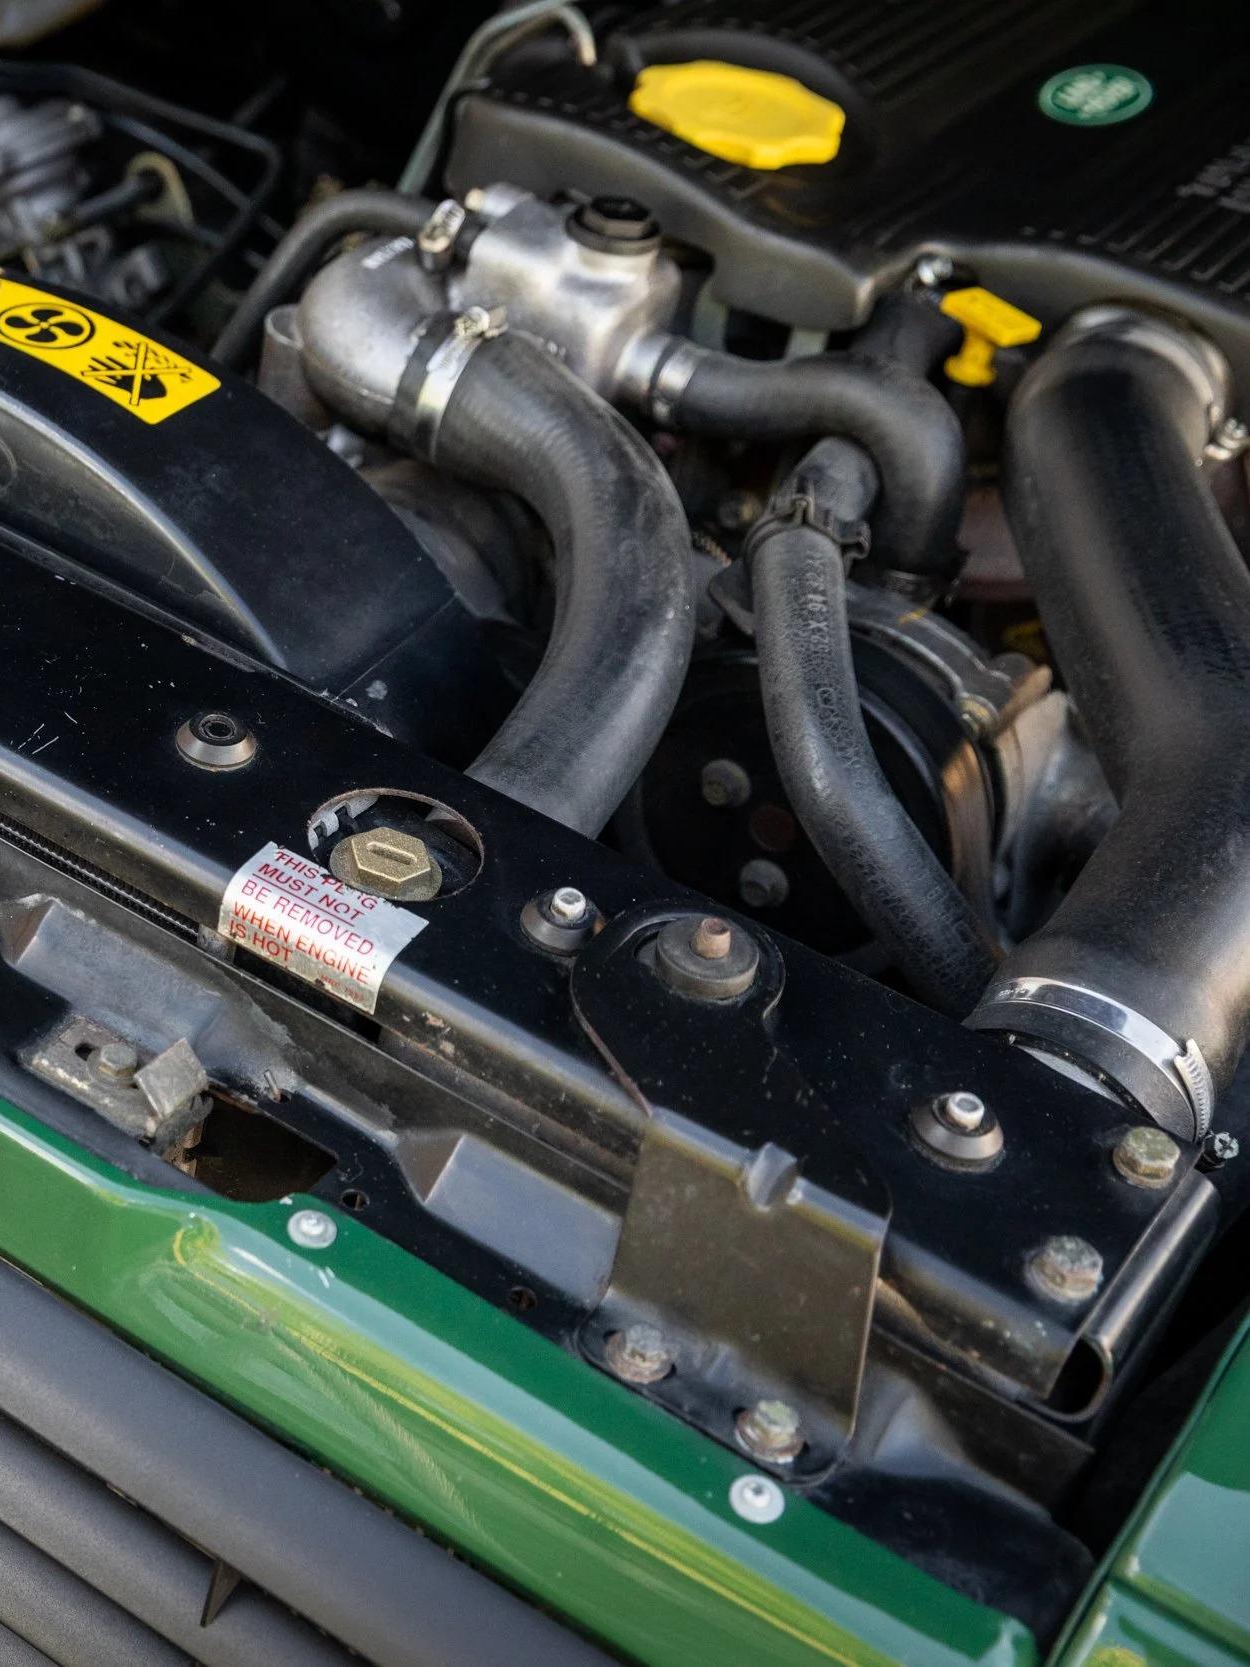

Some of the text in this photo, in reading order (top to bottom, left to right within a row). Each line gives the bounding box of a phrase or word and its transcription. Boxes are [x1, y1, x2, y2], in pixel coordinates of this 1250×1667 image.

[258, 863, 366, 920] MUST NOT
[275, 851, 378, 911] THIS PLG
[230, 920, 293, 961] IS HOT
[234, 901, 371, 984] WHEN ENGINE
[241, 879, 374, 955] BE REMOVED
